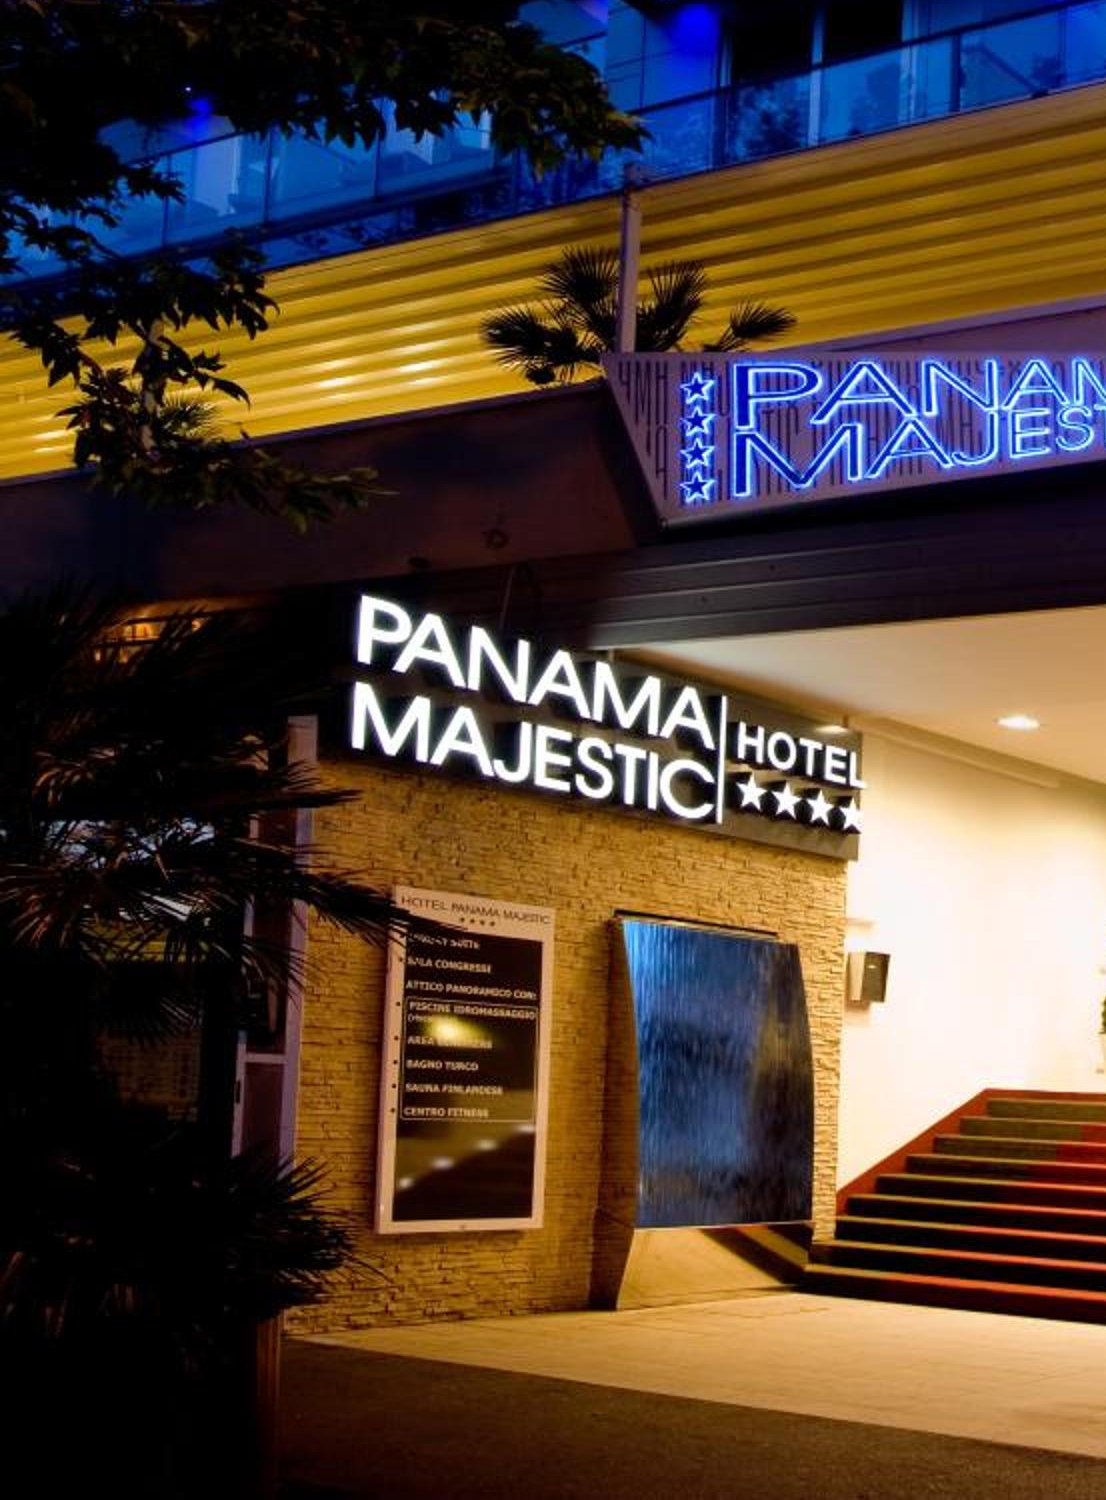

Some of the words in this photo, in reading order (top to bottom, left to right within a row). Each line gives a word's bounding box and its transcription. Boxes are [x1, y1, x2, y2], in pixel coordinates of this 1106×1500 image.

[356, 594, 716, 750] PANAMA
[351, 681, 716, 820] MAJESTIC
[735, 720, 865, 789] HOTEL
[401, 896, 447, 911] HOTEL
[451, 902, 500, 917] PANAMA
[503, 909, 550, 925] MAJESTIC
[405, 980, 444, 992] ATTICO
[445, 983, 513, 998] PANORAMICO
[409, 1001, 451, 1013] PISCINE
[405, 1059, 443, 1070] BAGNO
[444, 1061, 479, 1071] TURCO
[405, 1083, 441, 1093] SAUNA
[403, 1107, 447, 1117] CENTRO
